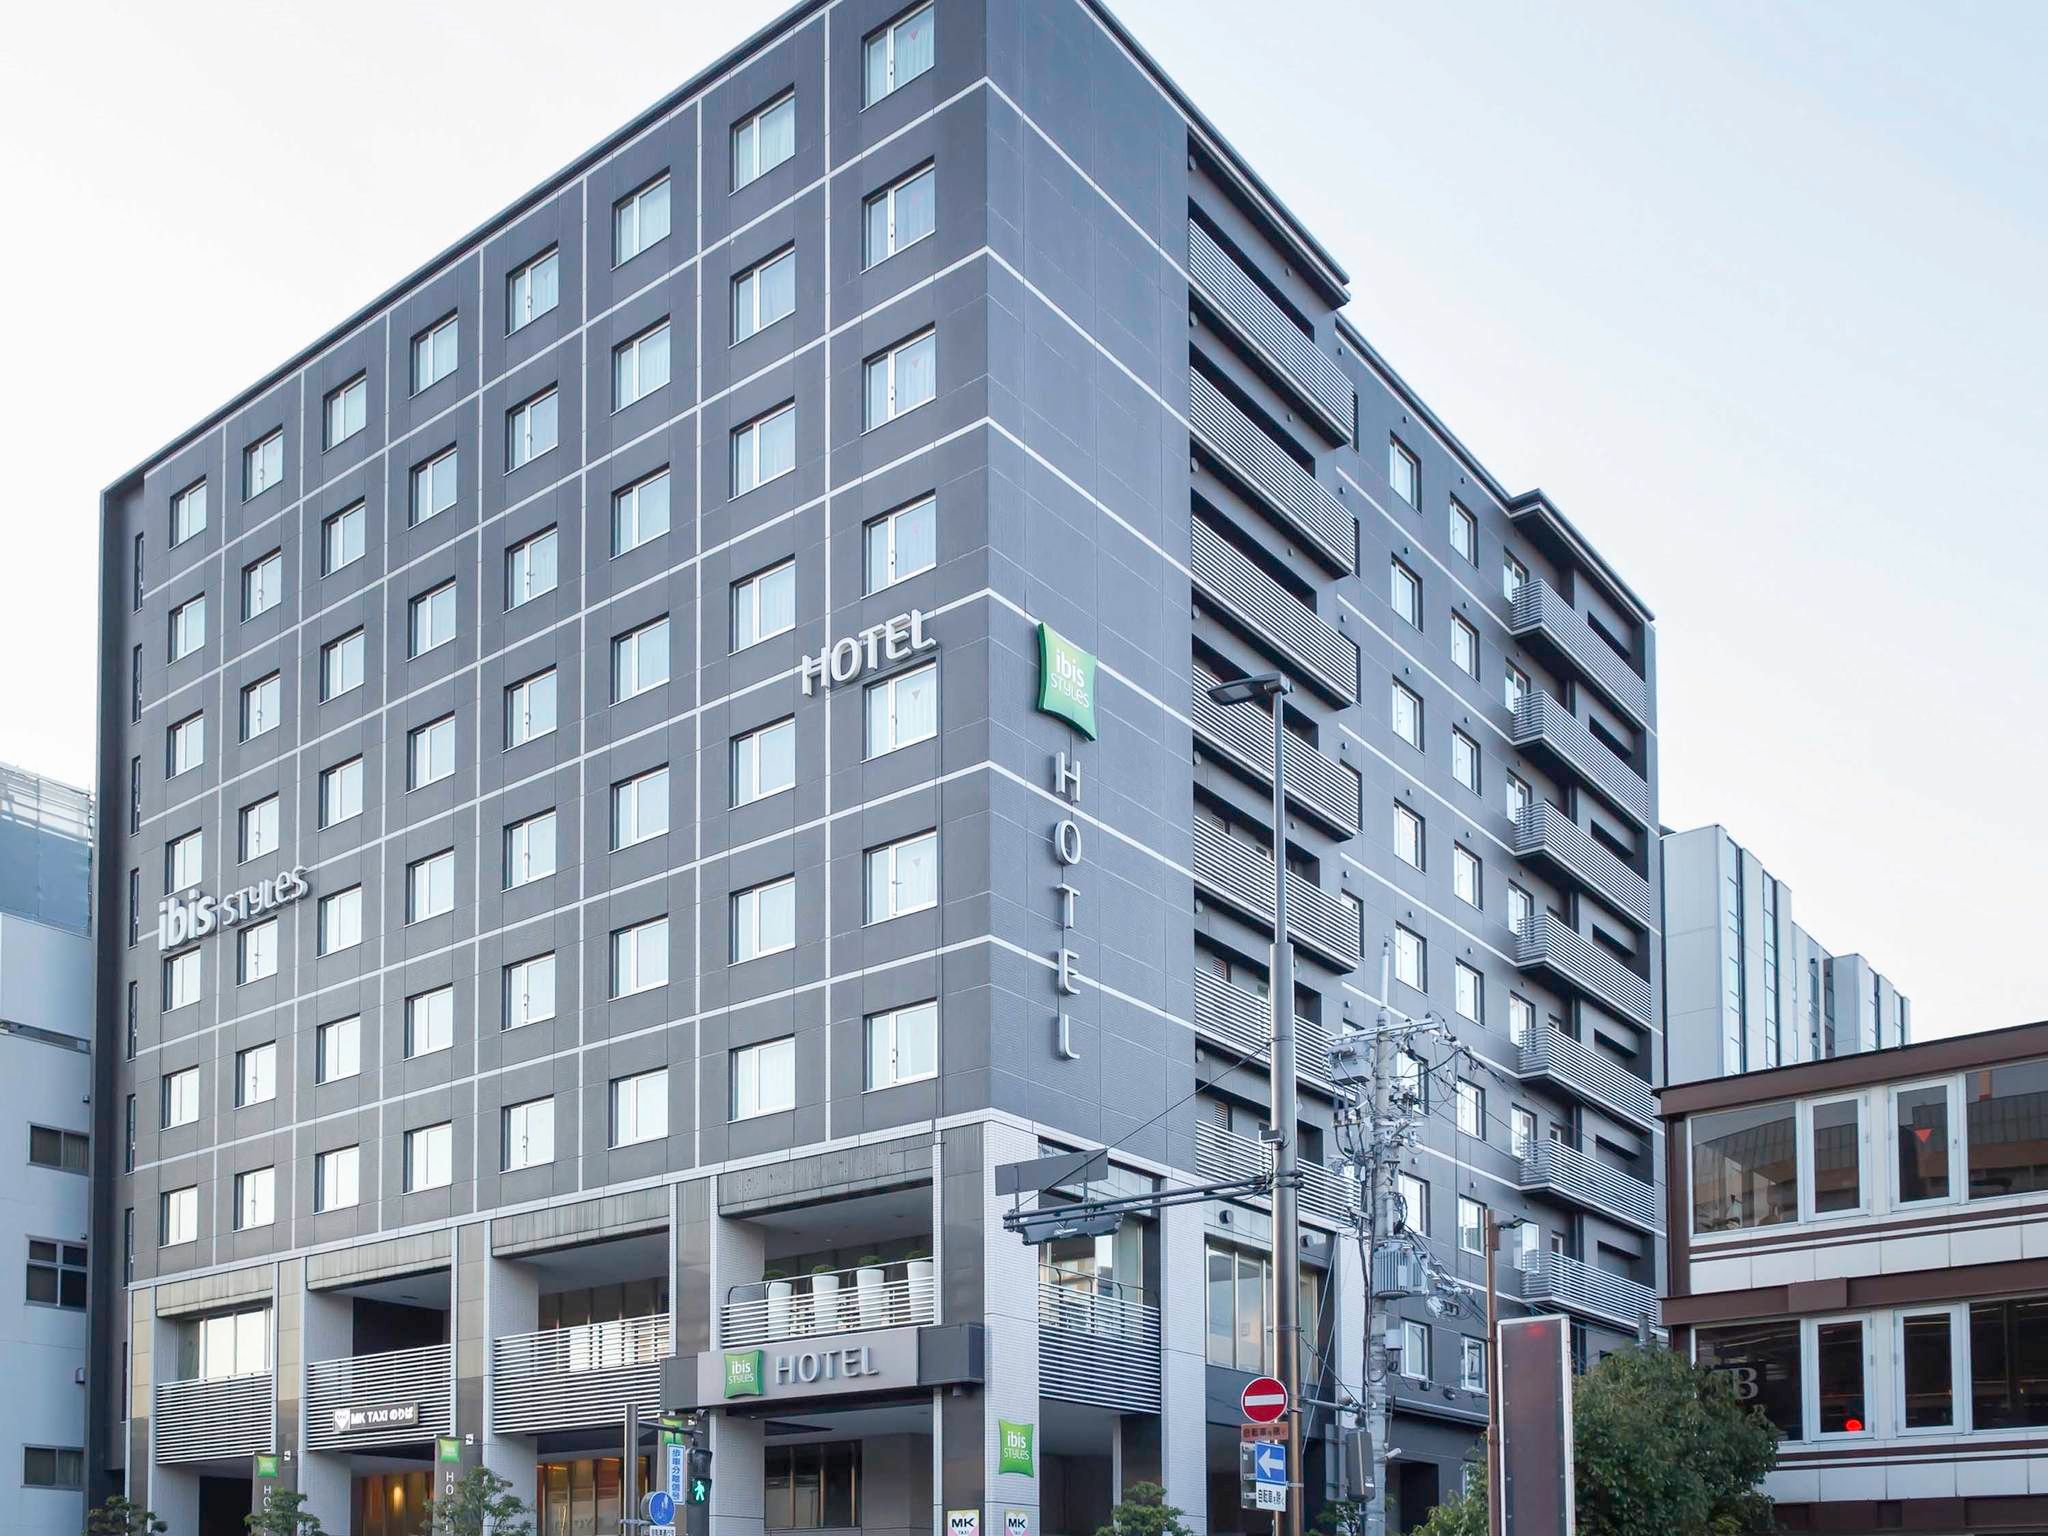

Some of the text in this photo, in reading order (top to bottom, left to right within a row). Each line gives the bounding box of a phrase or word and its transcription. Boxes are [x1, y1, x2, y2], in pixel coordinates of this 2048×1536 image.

[802, 609, 937, 695] HOTEL
[1055, 649, 1085, 688] ibis
[158, 888, 217, 951] ibis
[1055, 751, 1081, 1060] HOTEL
[731, 1359, 751, 1374] ibis
[775, 1344, 880, 1386] HOTEL
[350, 1412, 366, 1425] MK
[367, 1409, 388, 1423] TAXI
[1007, 1431, 1026, 1449] ibis
[951, 1517, 975, 1528] MK
[1008, 1517, 1026, 1529] MK
